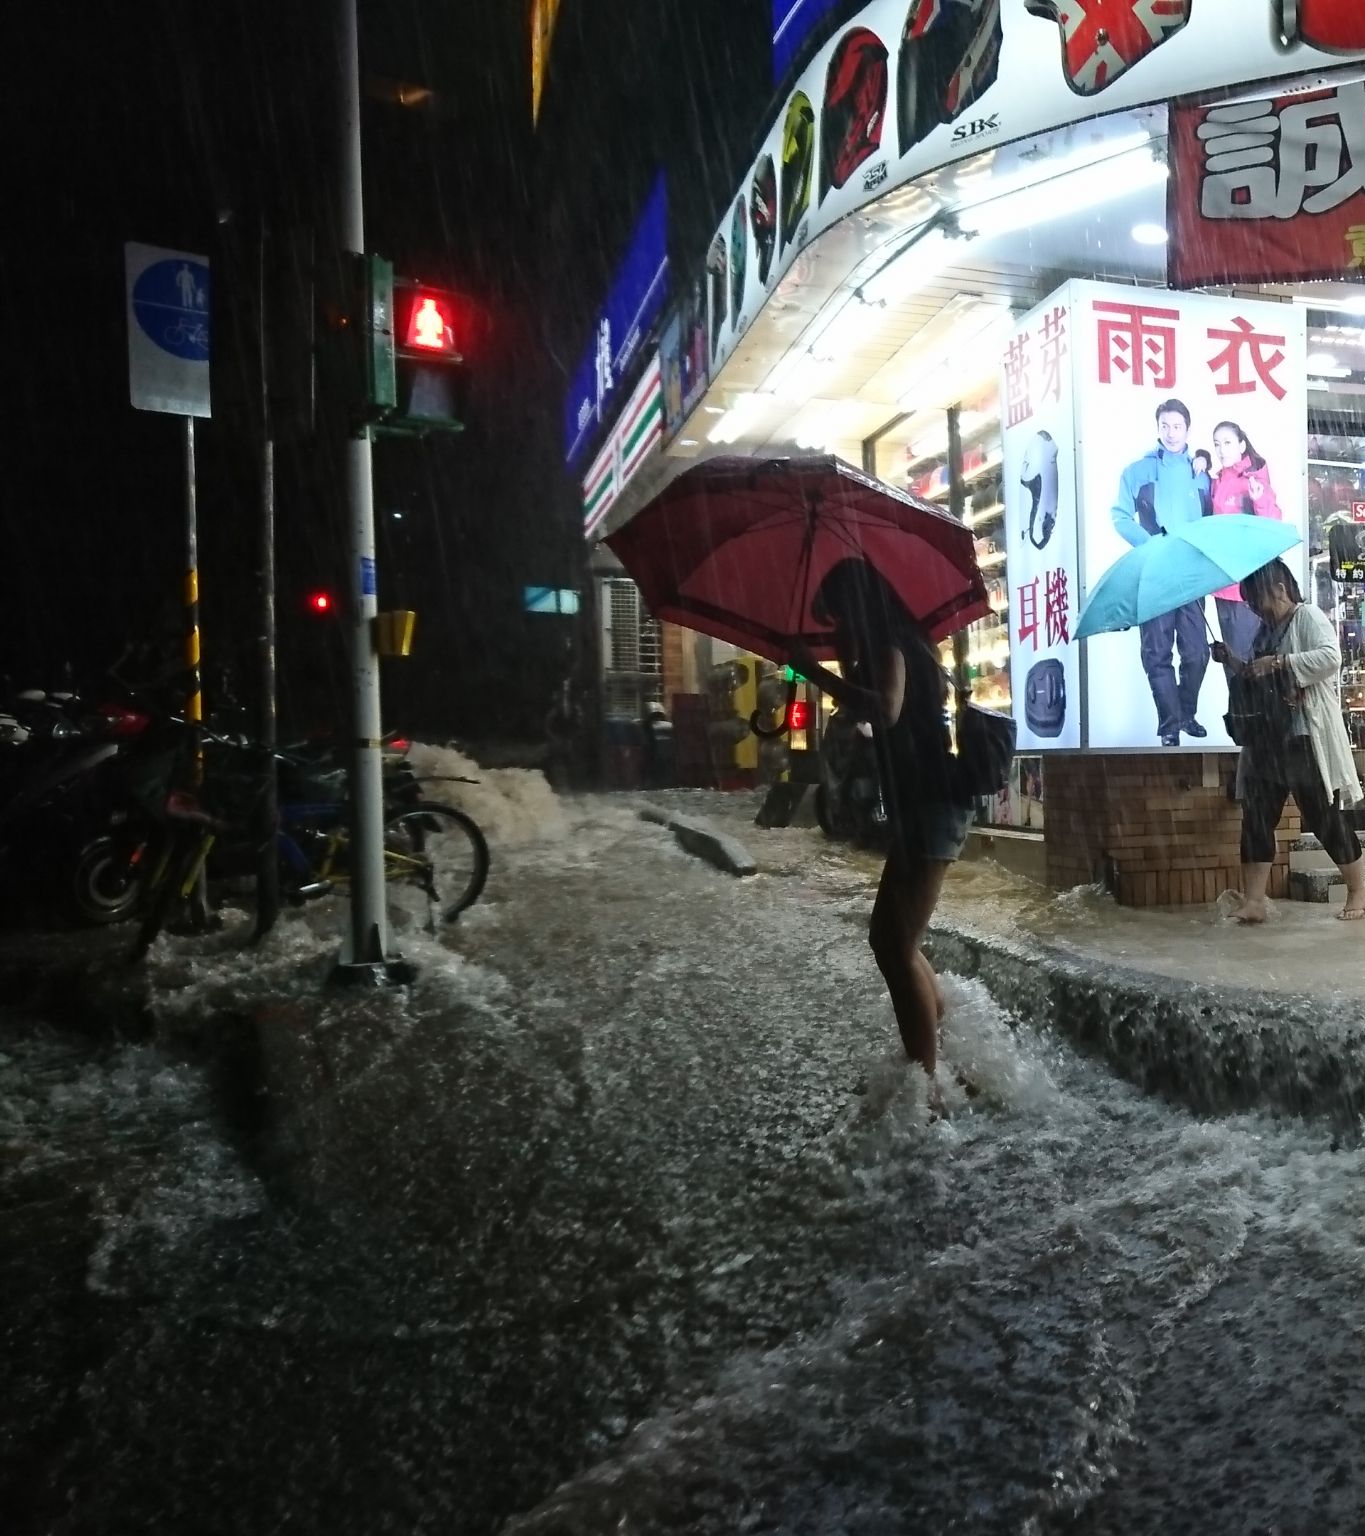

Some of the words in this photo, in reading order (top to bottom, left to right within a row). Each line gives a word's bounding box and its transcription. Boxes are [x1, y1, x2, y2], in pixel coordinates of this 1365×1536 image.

[1002, 305, 1067, 429] 藍芽
[1092, 300, 1288, 401] 雨衣
[1016, 567, 1070, 651] 耳機
